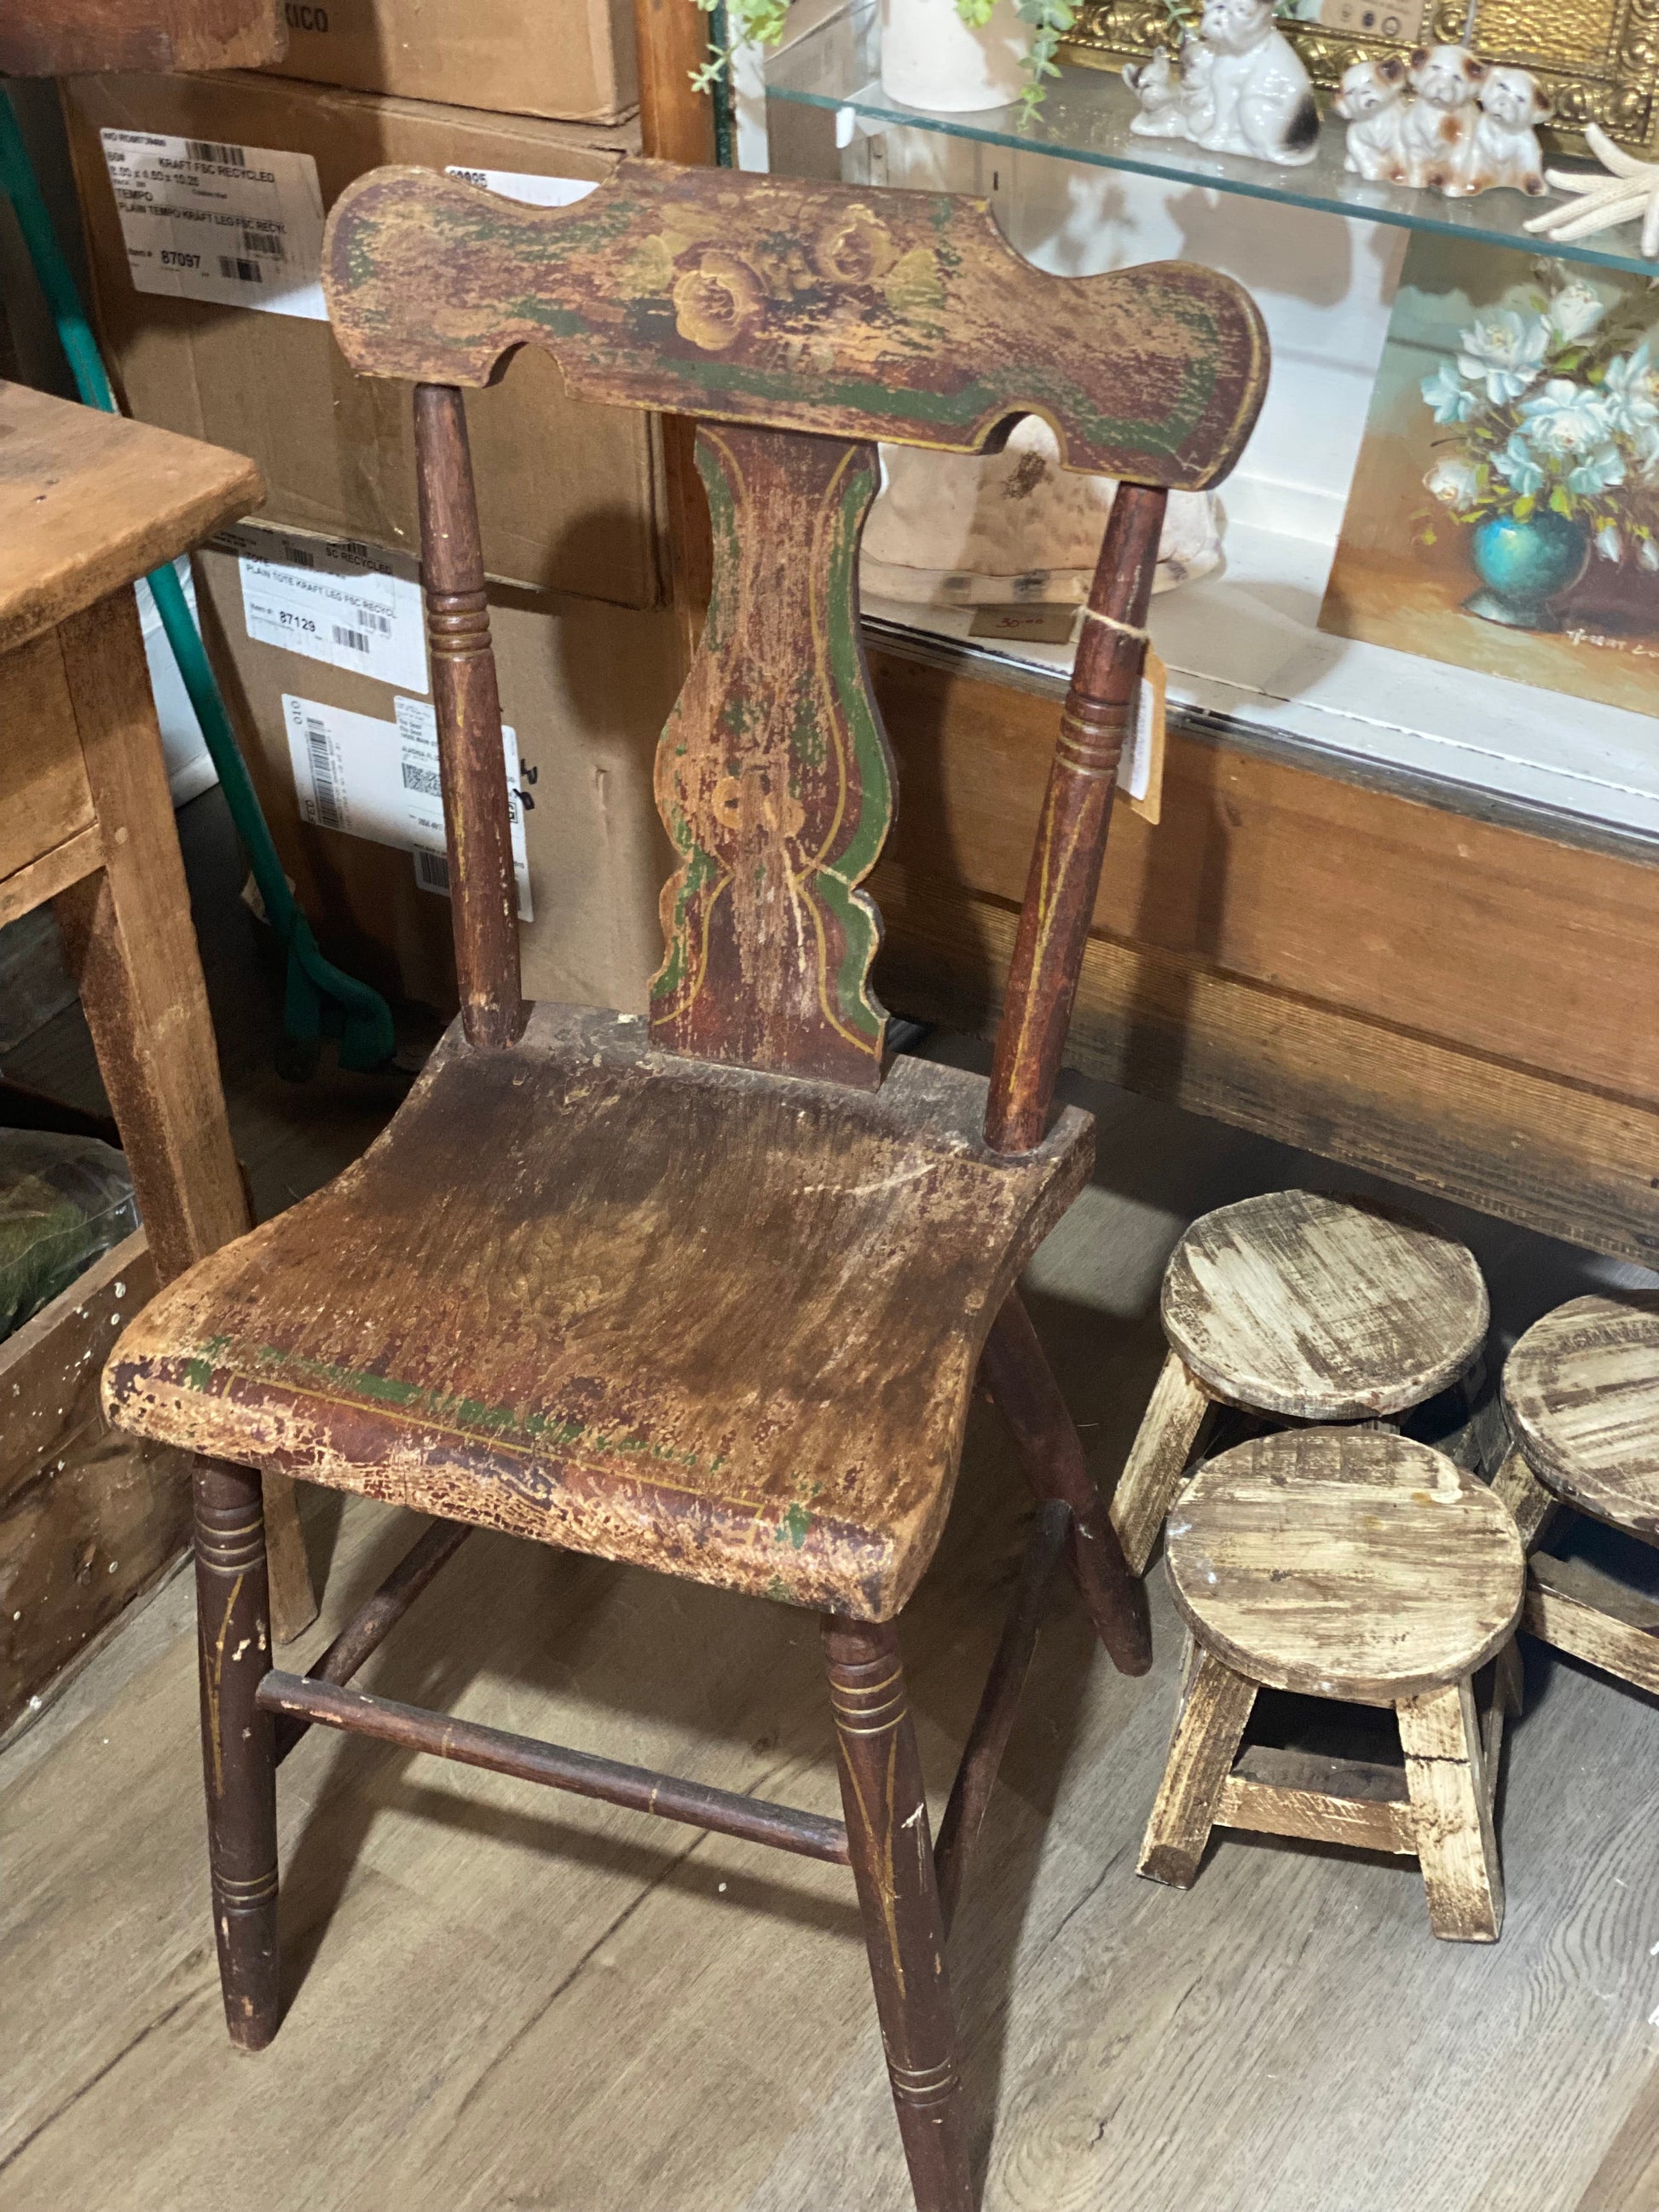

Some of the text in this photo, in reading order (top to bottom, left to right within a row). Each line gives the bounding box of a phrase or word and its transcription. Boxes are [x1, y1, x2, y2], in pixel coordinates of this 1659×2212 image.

[157, 158, 275, 183] KRAFT FSC RECYCLED
[114, 188, 153, 202] TEMPO
[118, 202, 147, 214] PLAIN
[147, 205, 181, 218] TEMPO
[182, 211, 212, 223] KRAFT
[160, 250, 201, 269] 87097
[341, 552, 393, 576] RECYCLED
[246, 563, 271, 579] PLAIN
[295, 580, 323, 595] KRAFT
[325, 587, 342, 602] LEG
[344, 594, 361, 607] FSC
[279, 610, 316, 632] 87129
